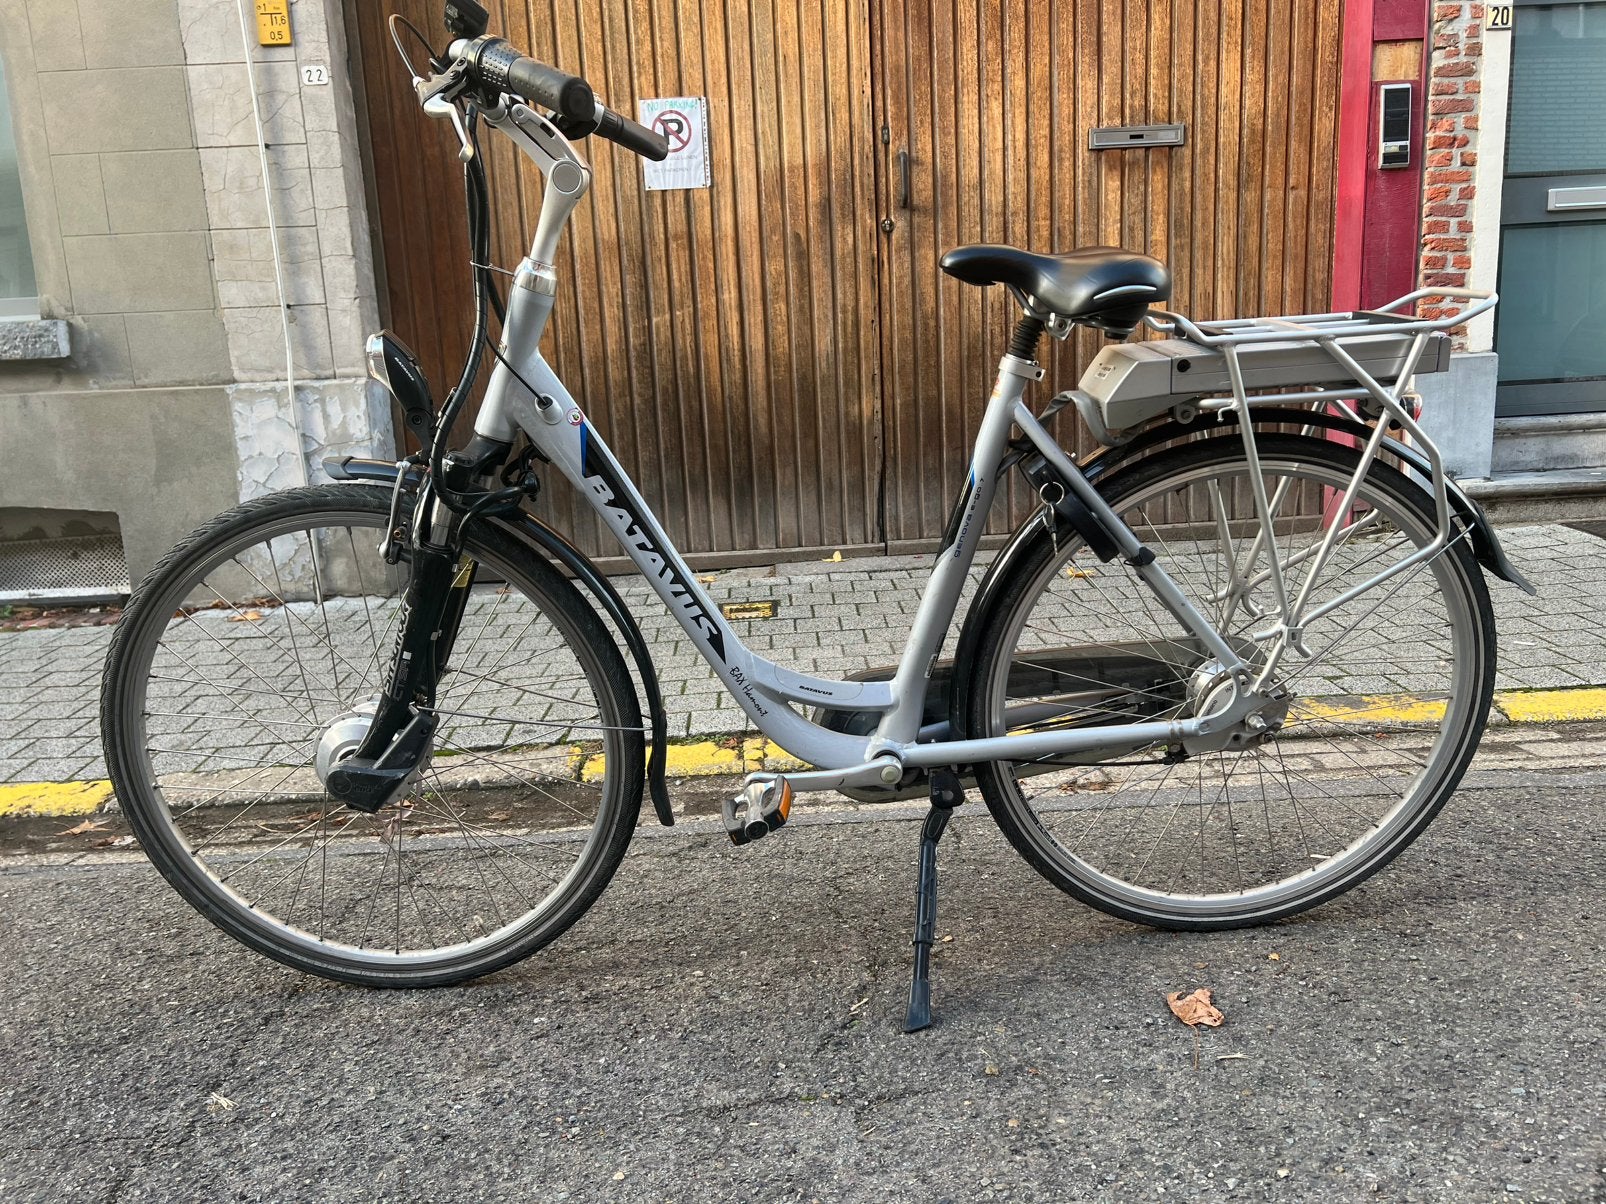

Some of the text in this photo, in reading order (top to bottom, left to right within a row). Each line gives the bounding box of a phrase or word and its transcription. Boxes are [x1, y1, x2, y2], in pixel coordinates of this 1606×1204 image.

[1492, 6, 1509, 26] 20
[305, 68, 323, 82] 22
[954, 514, 973, 558] genova
[585, 474, 718, 641] BATAVUS
[729, 666, 748, 686] BAX
[798, 685, 834, 696] BATAVUS
